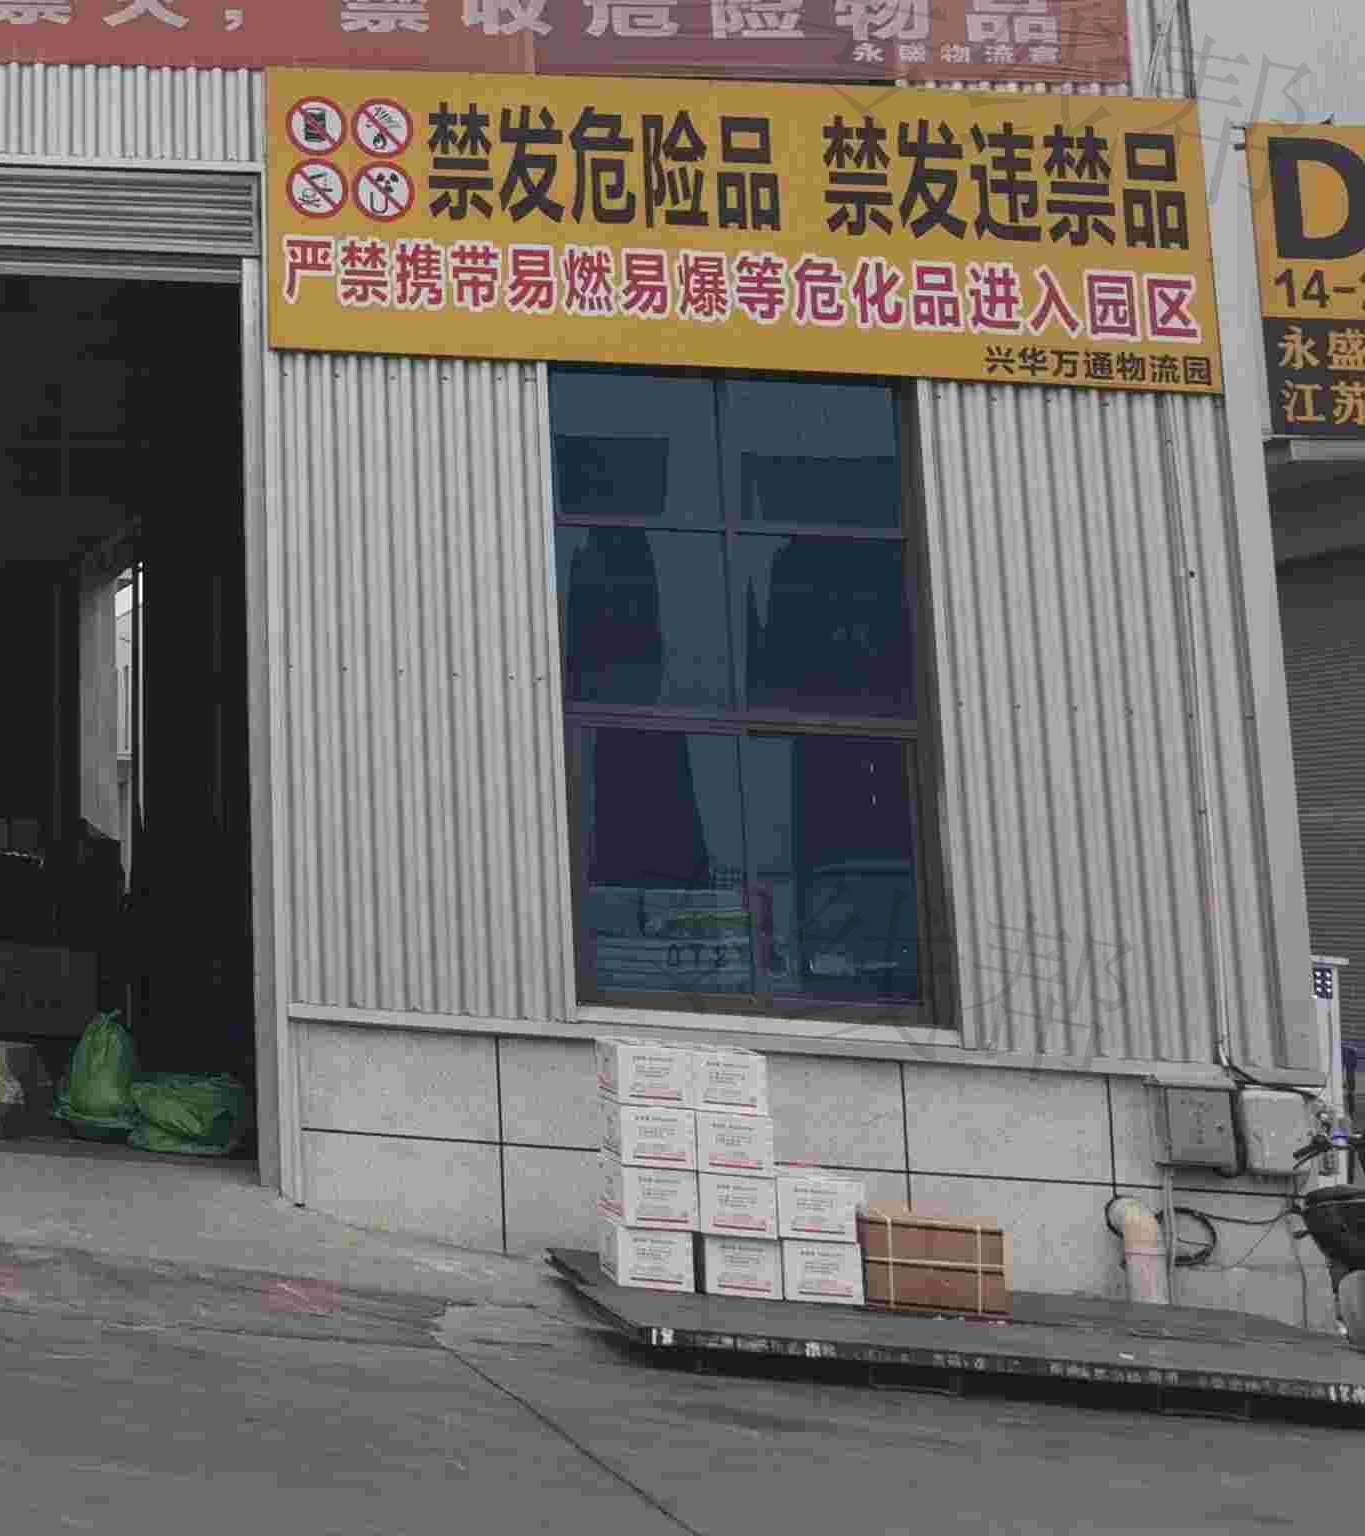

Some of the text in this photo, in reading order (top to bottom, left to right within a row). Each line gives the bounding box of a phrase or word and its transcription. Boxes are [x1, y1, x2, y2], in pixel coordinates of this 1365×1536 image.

[428, 101, 1190, 250] 禁发危险品 禁发违禁品
[283, 235, 1201, 344] 严禁携带易燃易爆等危化品进入园区
[1273, 267, 1365, 310] 14-
[983, 345, 1214, 388] 兴华万通物流园
